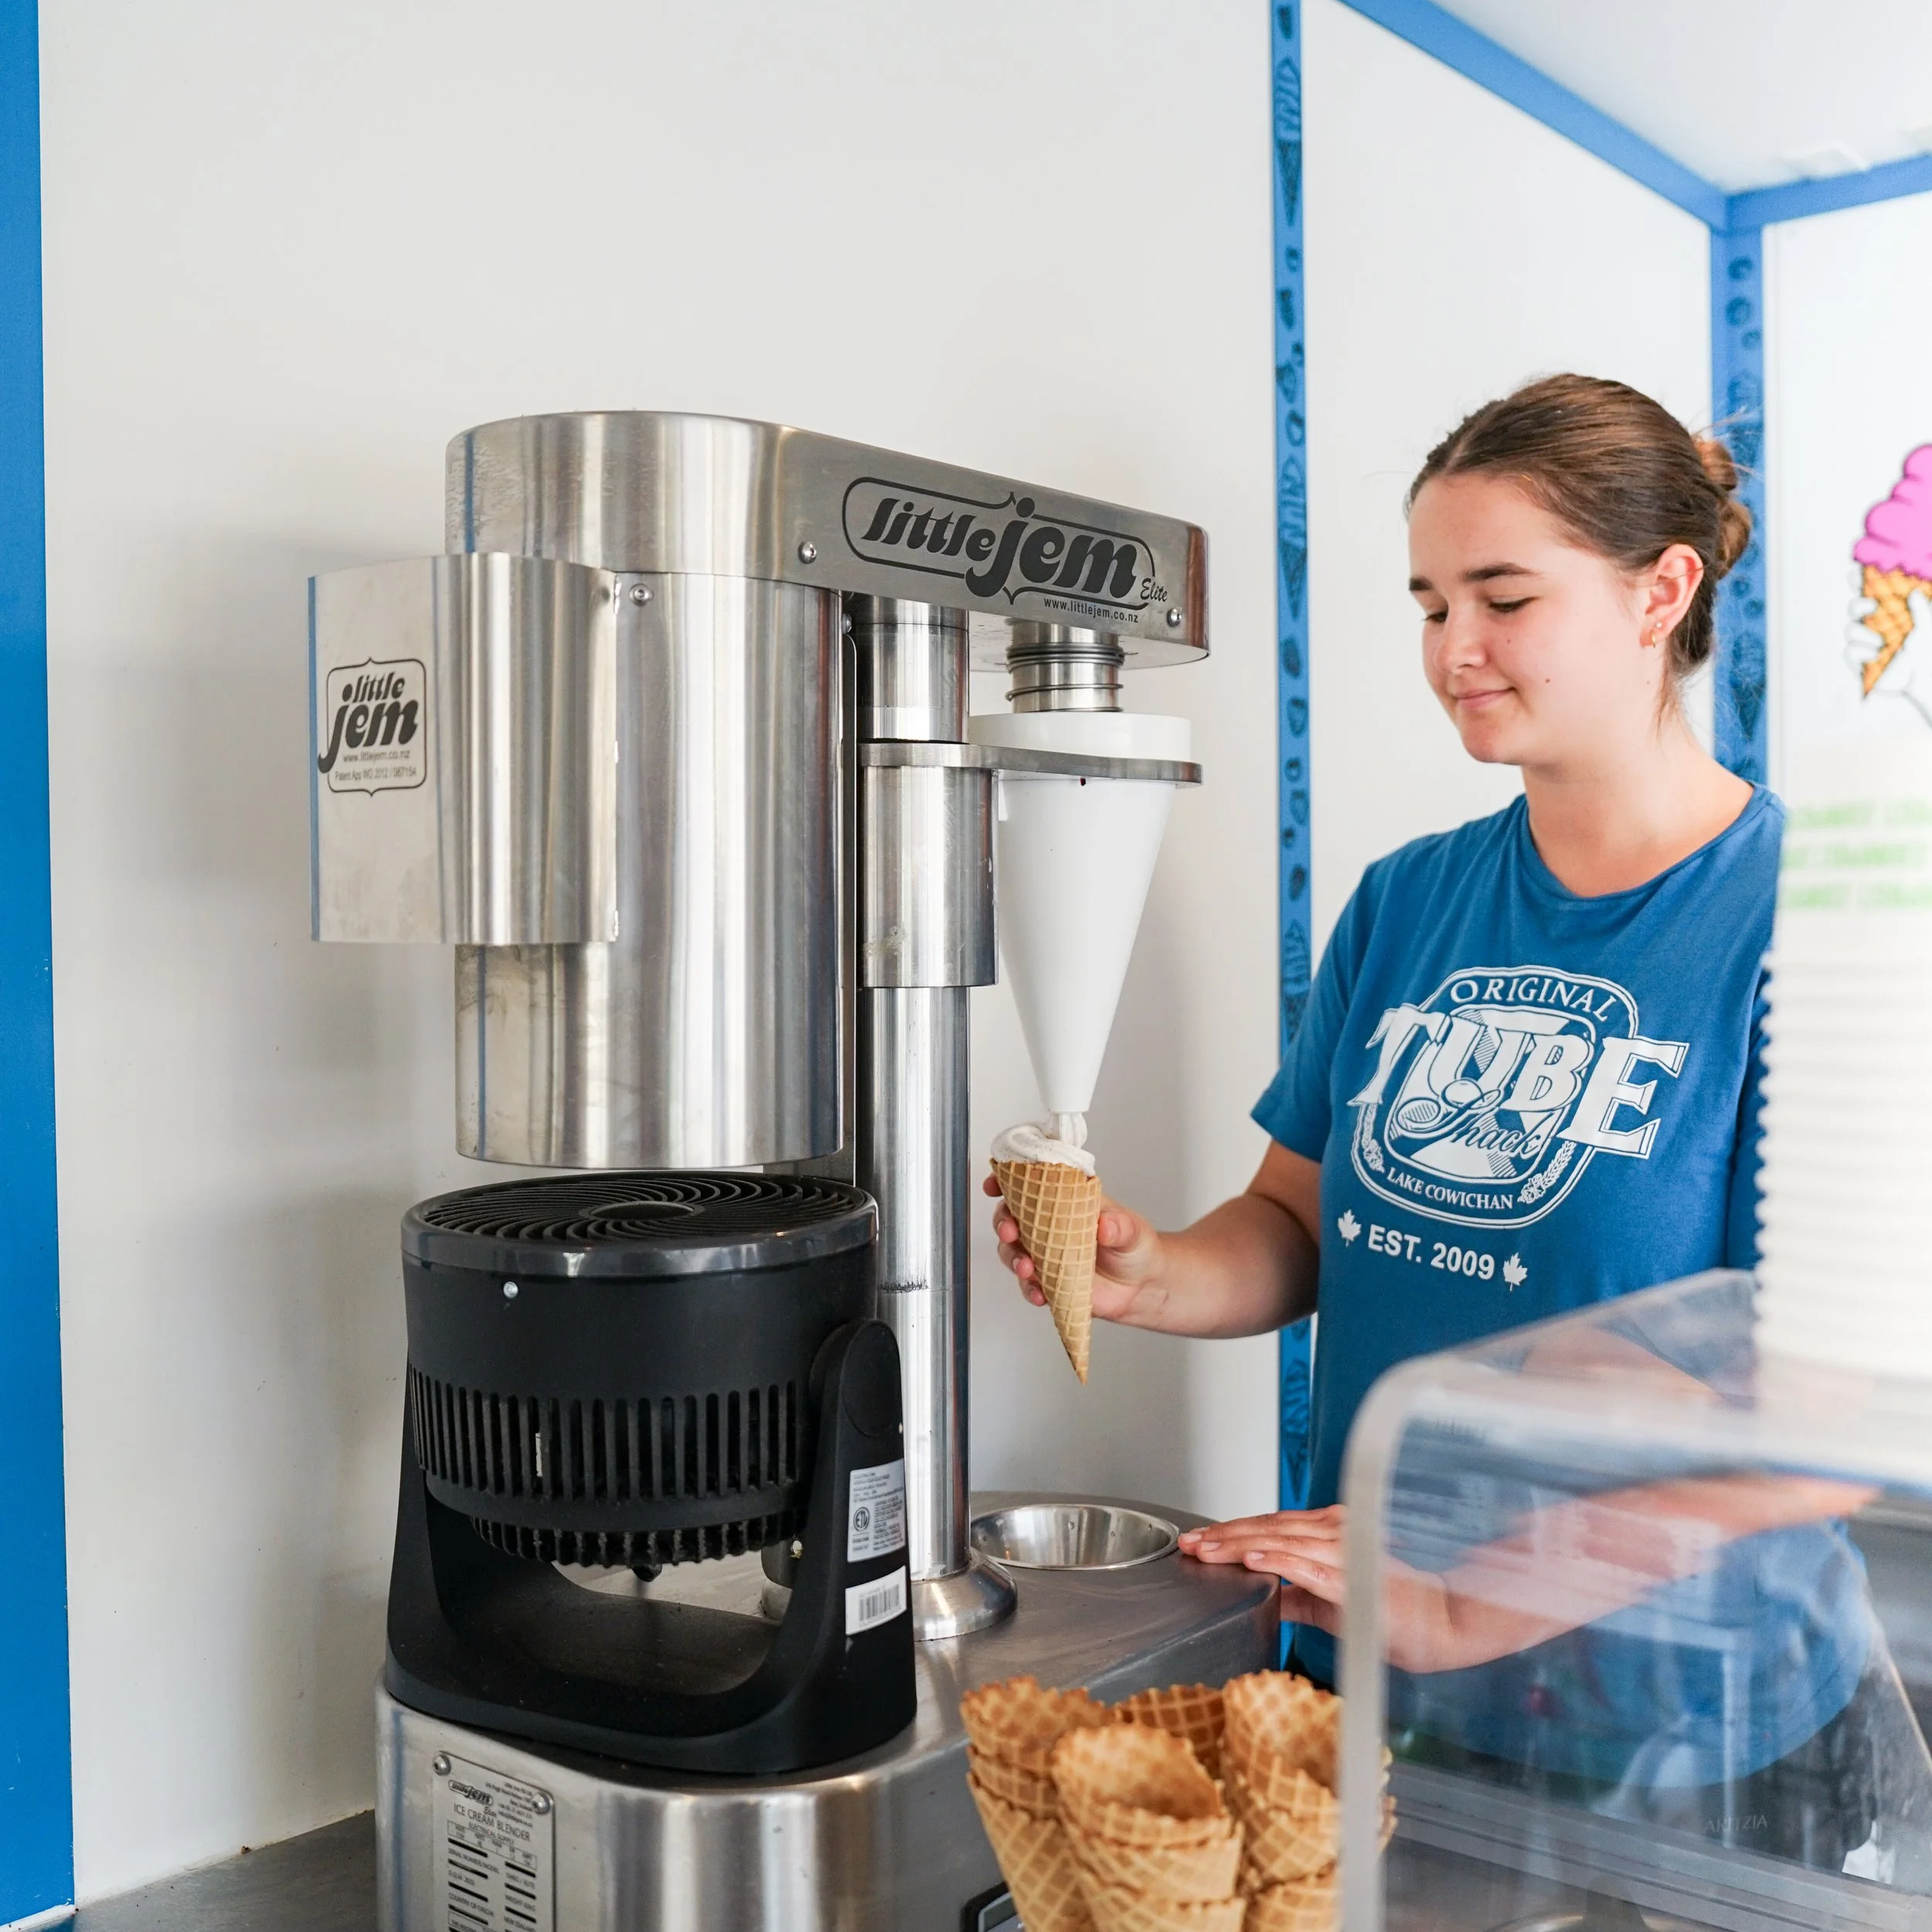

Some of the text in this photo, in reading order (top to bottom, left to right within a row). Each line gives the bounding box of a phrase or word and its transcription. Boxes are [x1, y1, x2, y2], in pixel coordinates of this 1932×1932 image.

[1043, 597, 1139, 624] www.littlejem.co.nz
[1139, 577, 1168, 602] Elite
[352, 672, 405, 703] little
[318, 683, 419, 774] jem
[1450, 976, 1617, 1022] ORIGINAL
[1347, 1003, 1689, 1159] TUBE
[1391, 1077, 1552, 1159] Shack
[1386, 1167, 1514, 1210] LAKE COWICHAN
[1367, 1224, 1495, 1281] EST. 2009
[454, 1803, 465, 1817] ICE
[467, 1808, 495, 1829] CREAM
[497, 1817, 531, 1842] BLENDER
